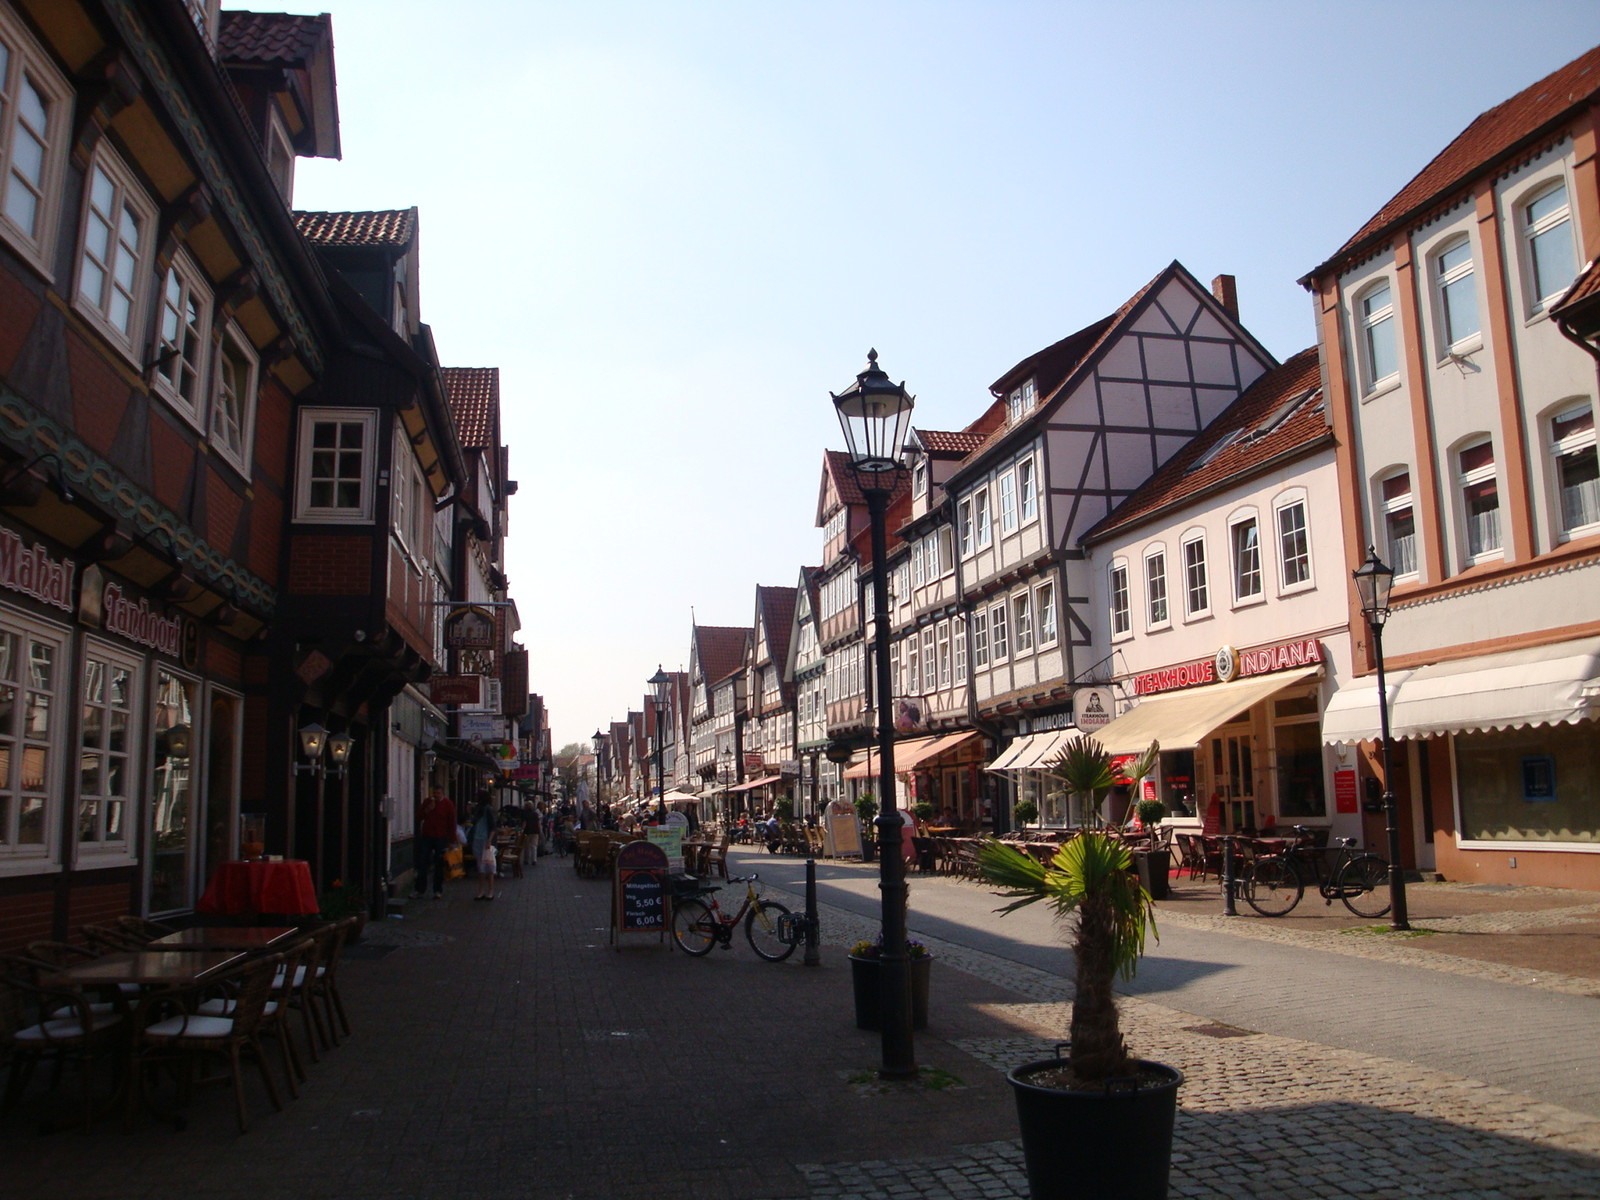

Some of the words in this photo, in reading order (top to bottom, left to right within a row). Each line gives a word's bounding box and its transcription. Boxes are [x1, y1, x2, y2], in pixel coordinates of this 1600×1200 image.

[0, 525, 76, 613] Mahal
[104, 581, 181, 658] Tandoori
[1239, 639, 1321, 676] INDIANA
[1133, 660, 1214, 695] STEAKHOUSE
[636, 898, 654, 908] 5,50
[656, 897, 662, 905] €
[636, 916, 655, 926] 6,00
[656, 914, 663, 922] €
